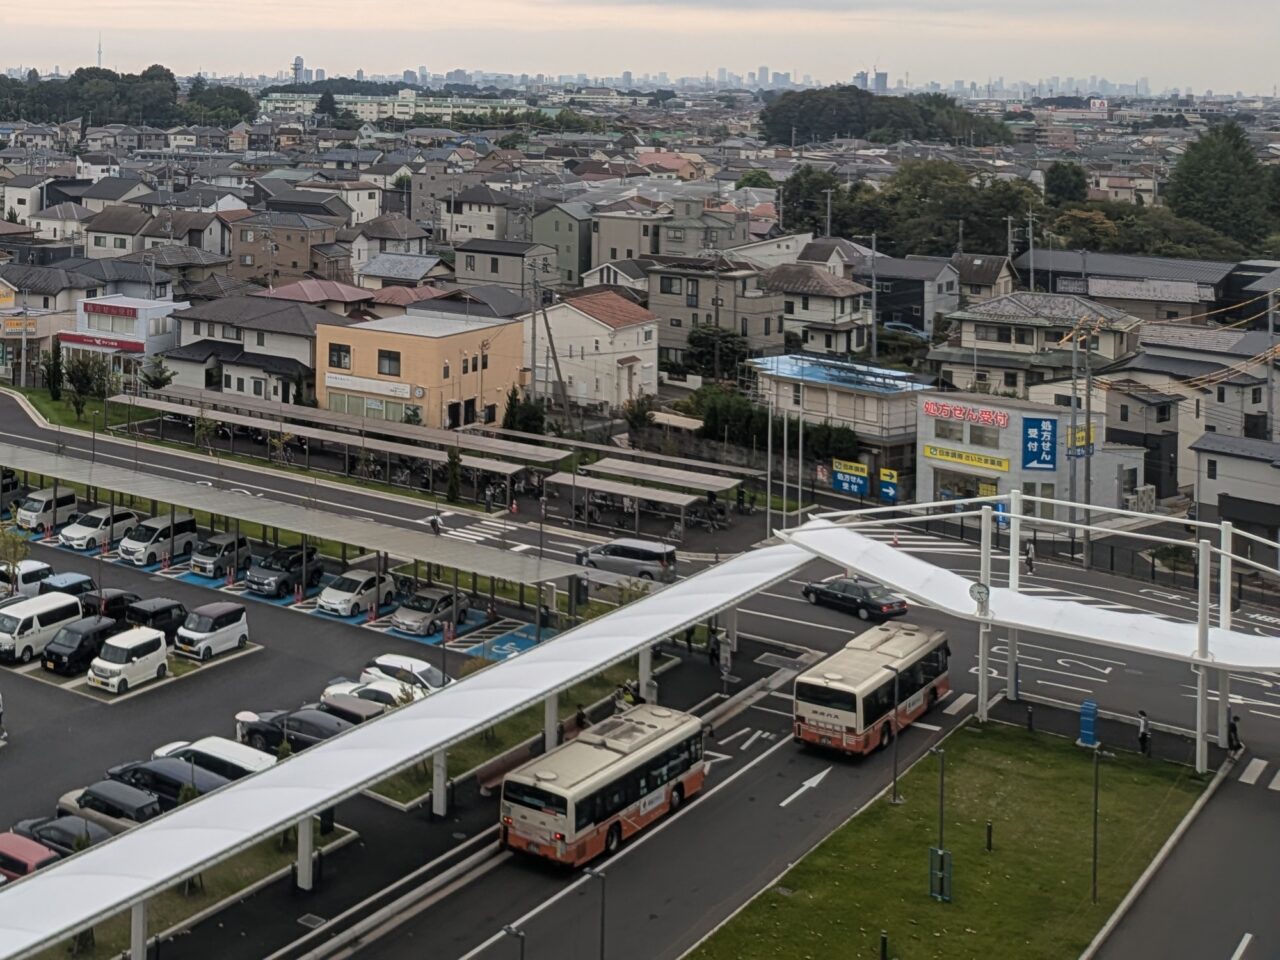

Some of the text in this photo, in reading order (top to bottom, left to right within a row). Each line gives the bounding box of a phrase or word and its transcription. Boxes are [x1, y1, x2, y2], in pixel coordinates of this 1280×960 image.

[923, 401, 1009, 428] 処方せん受付
[1027, 428, 1038, 452] 受付
[1040, 420, 1052, 461] 処方せん
